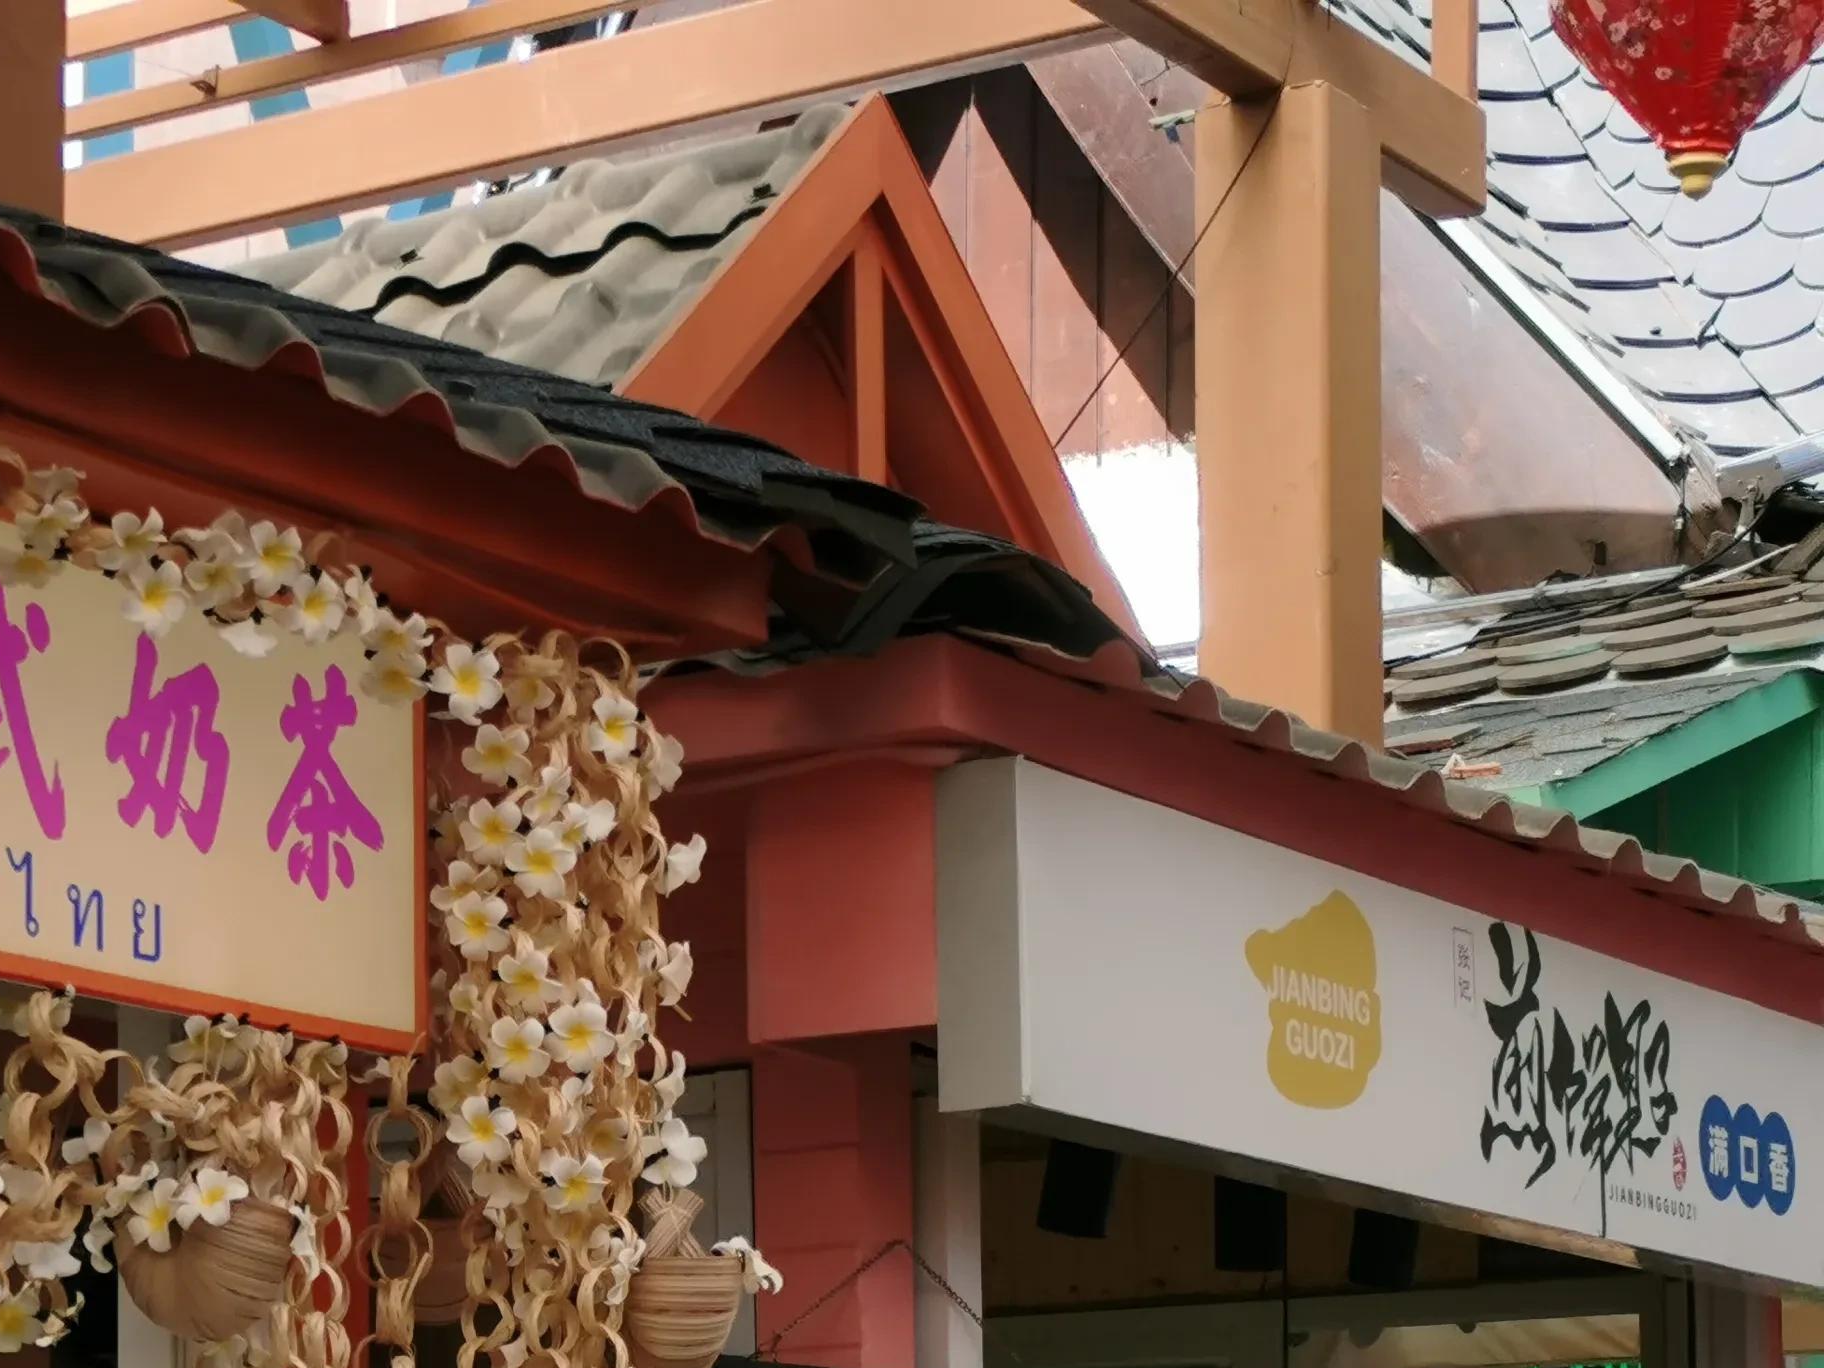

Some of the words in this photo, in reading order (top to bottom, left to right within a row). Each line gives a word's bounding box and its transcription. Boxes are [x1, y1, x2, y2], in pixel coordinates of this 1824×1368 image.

[1270, 965, 1371, 1026] JIANBING
[1285, 1018, 1356, 1071] GUOZI
[1707, 1123, 1792, 1197] 满口香
